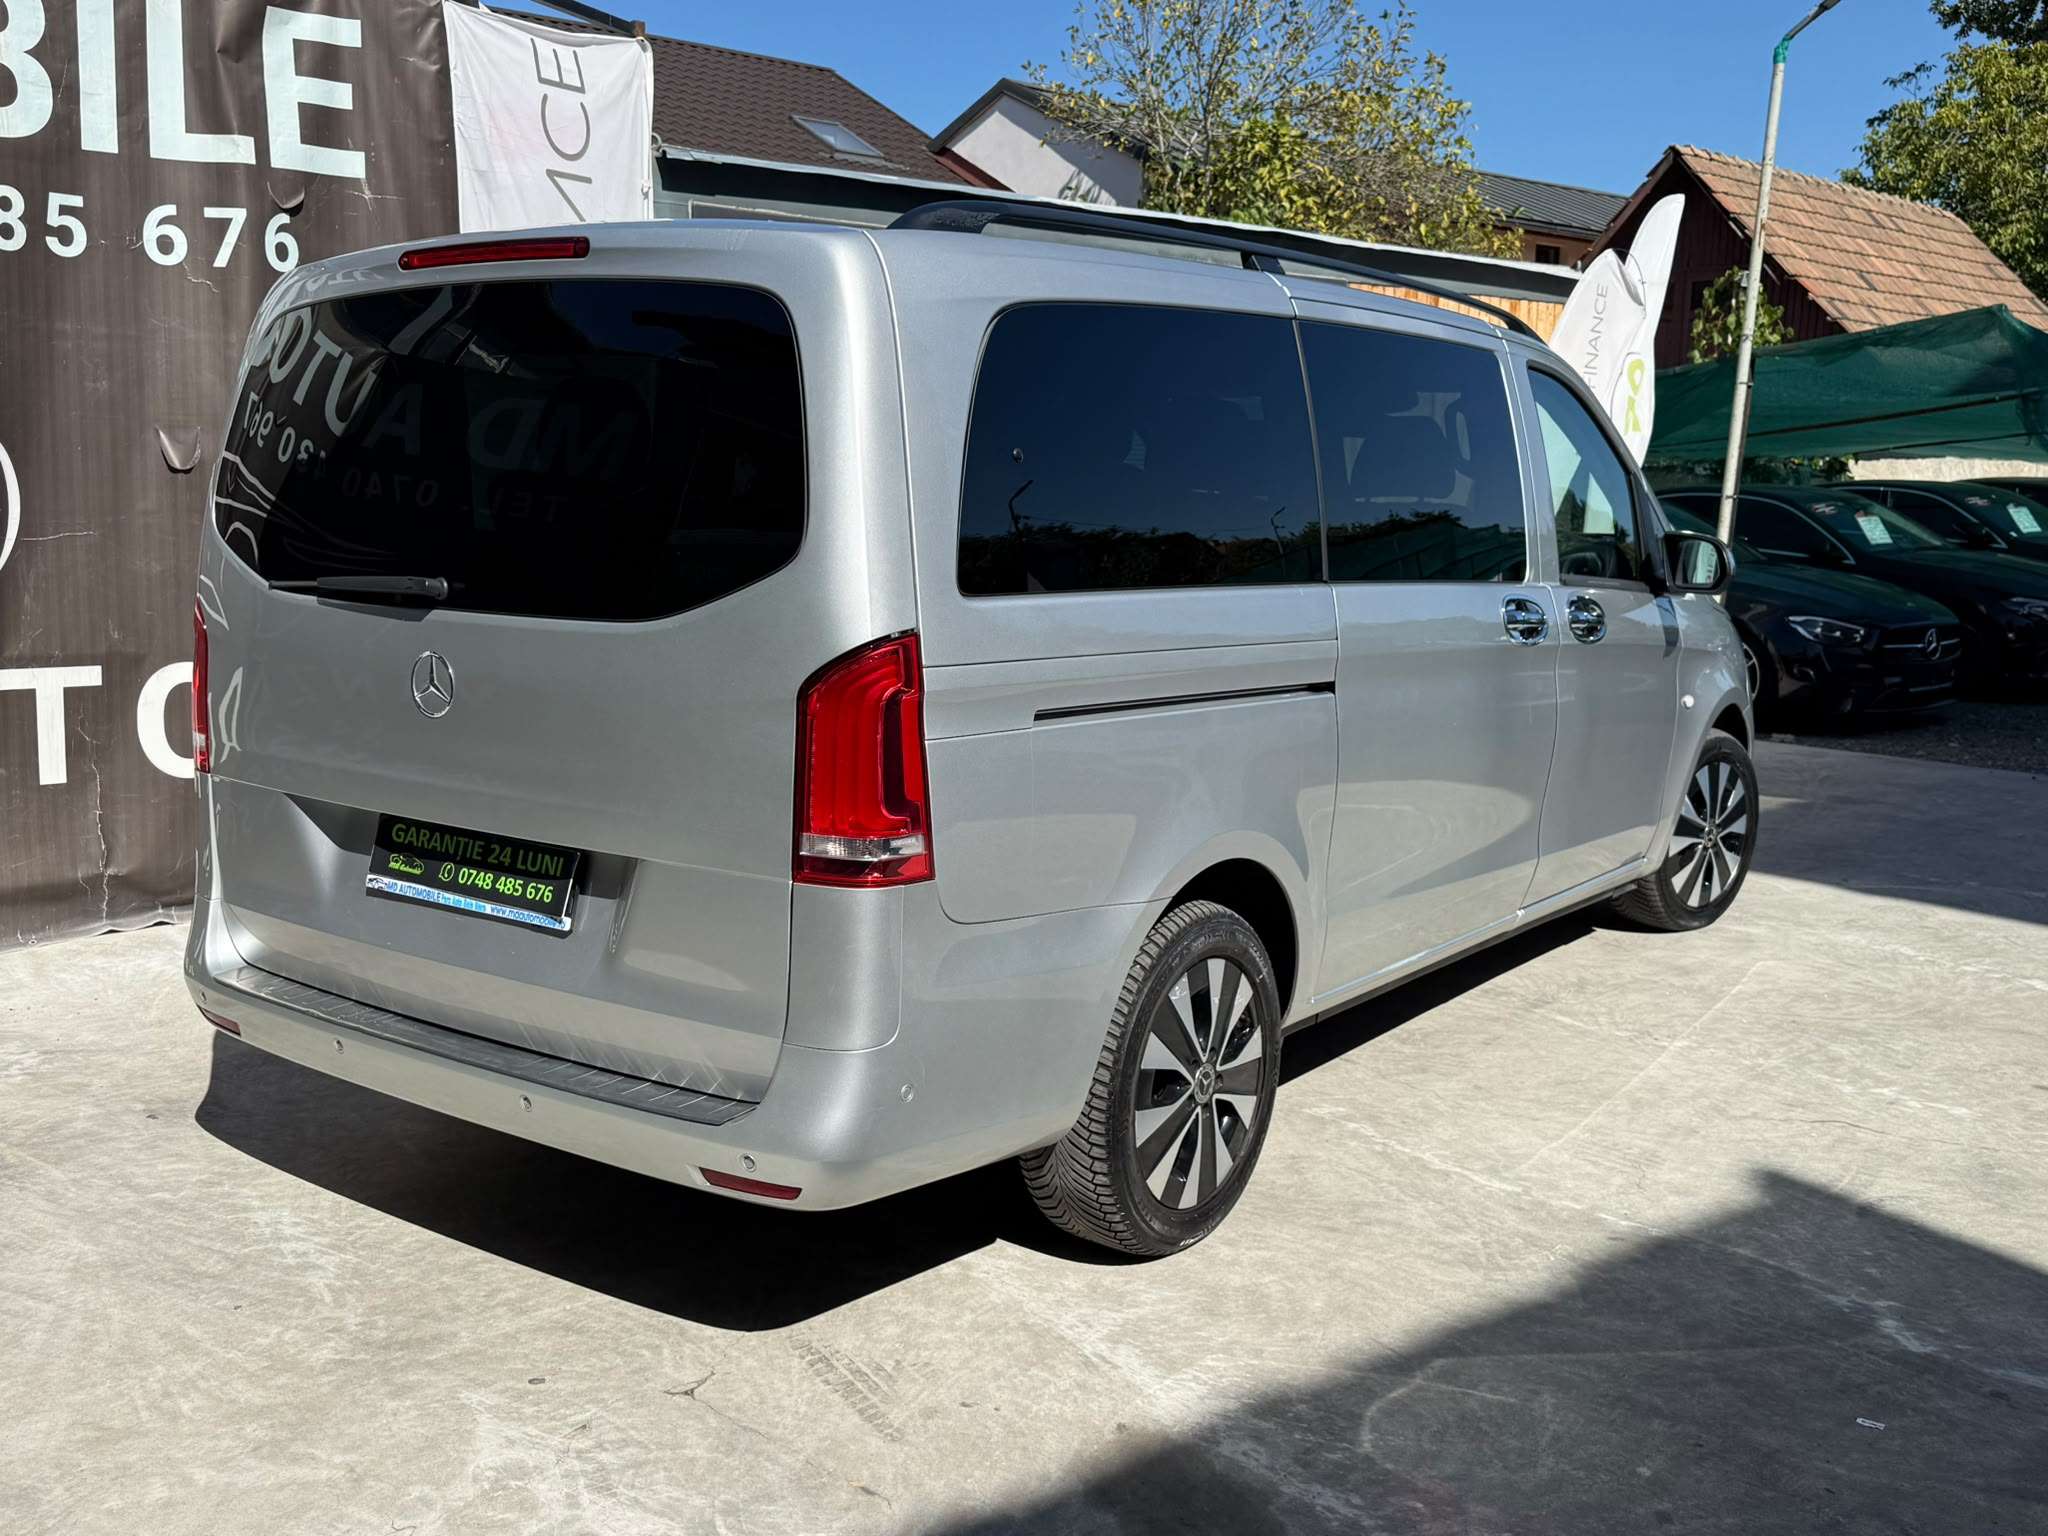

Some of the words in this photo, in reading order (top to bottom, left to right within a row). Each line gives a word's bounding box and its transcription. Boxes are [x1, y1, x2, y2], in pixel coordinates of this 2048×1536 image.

[143, 204, 299, 273] 676
[487, 844, 511, 866] 24
[517, 847, 563, 876] LUNI
[458, 867, 492, 890] 0748
[496, 876, 523, 898] 485
[526, 882, 554, 904] 676
